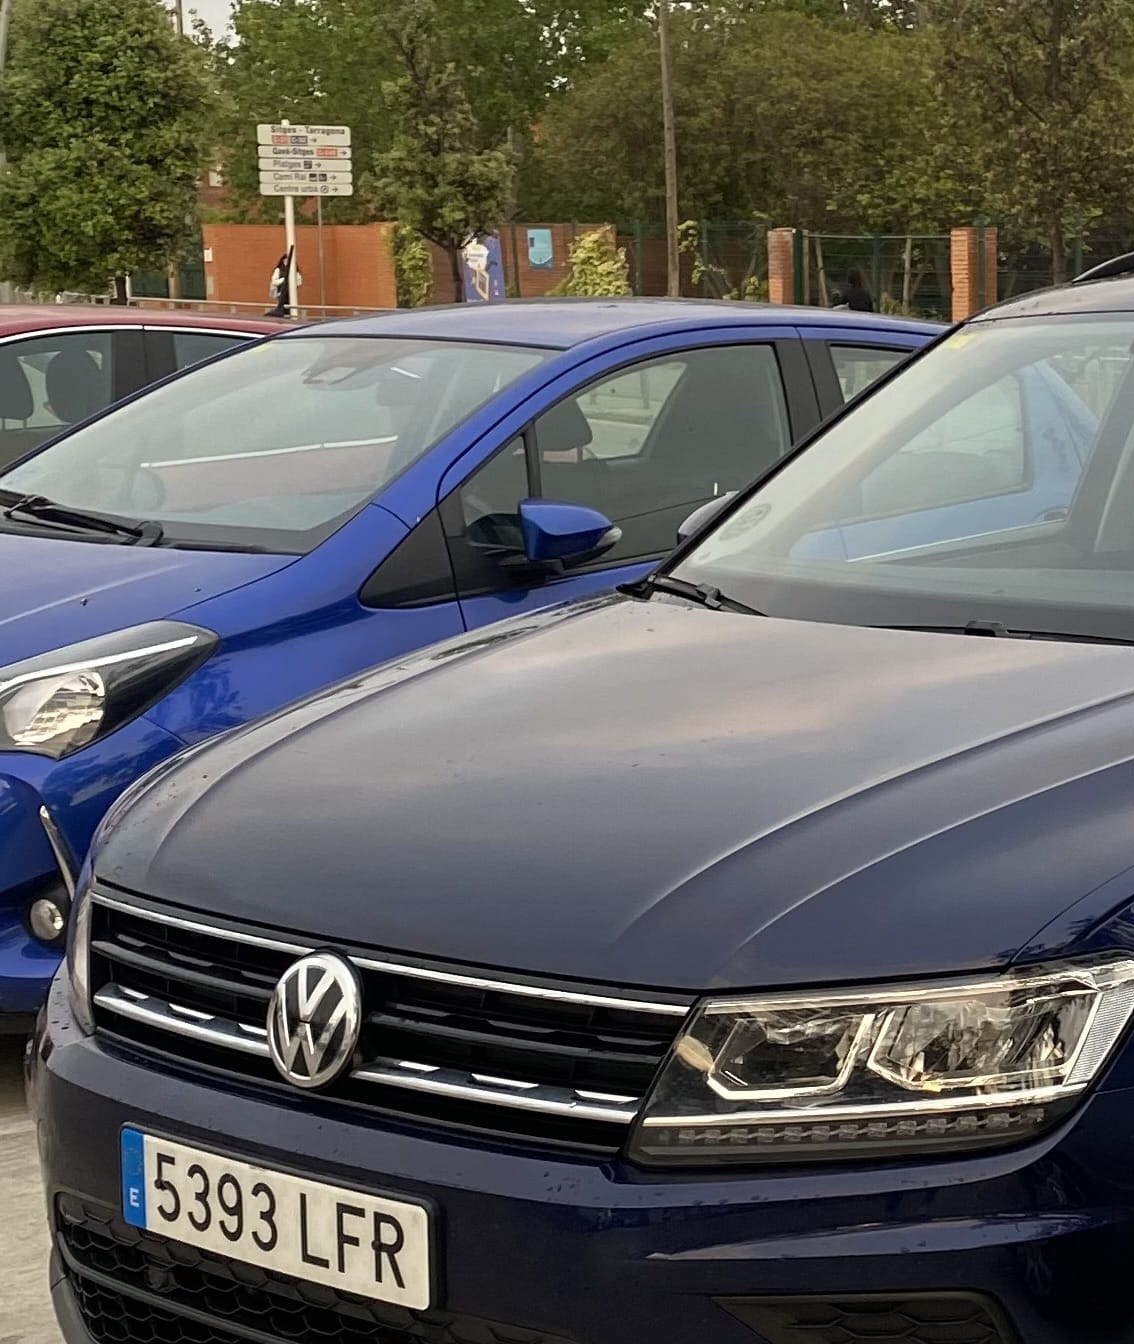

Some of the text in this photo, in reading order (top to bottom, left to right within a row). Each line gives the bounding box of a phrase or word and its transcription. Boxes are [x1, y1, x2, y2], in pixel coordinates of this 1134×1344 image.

[305, 126, 345, 136] Tarragona
[273, 159, 301, 169] Platges
[274, 184, 299, 192] Centre
[129, 1188, 139, 1207] E
[154, 1152, 406, 1289] 5393 LFR
